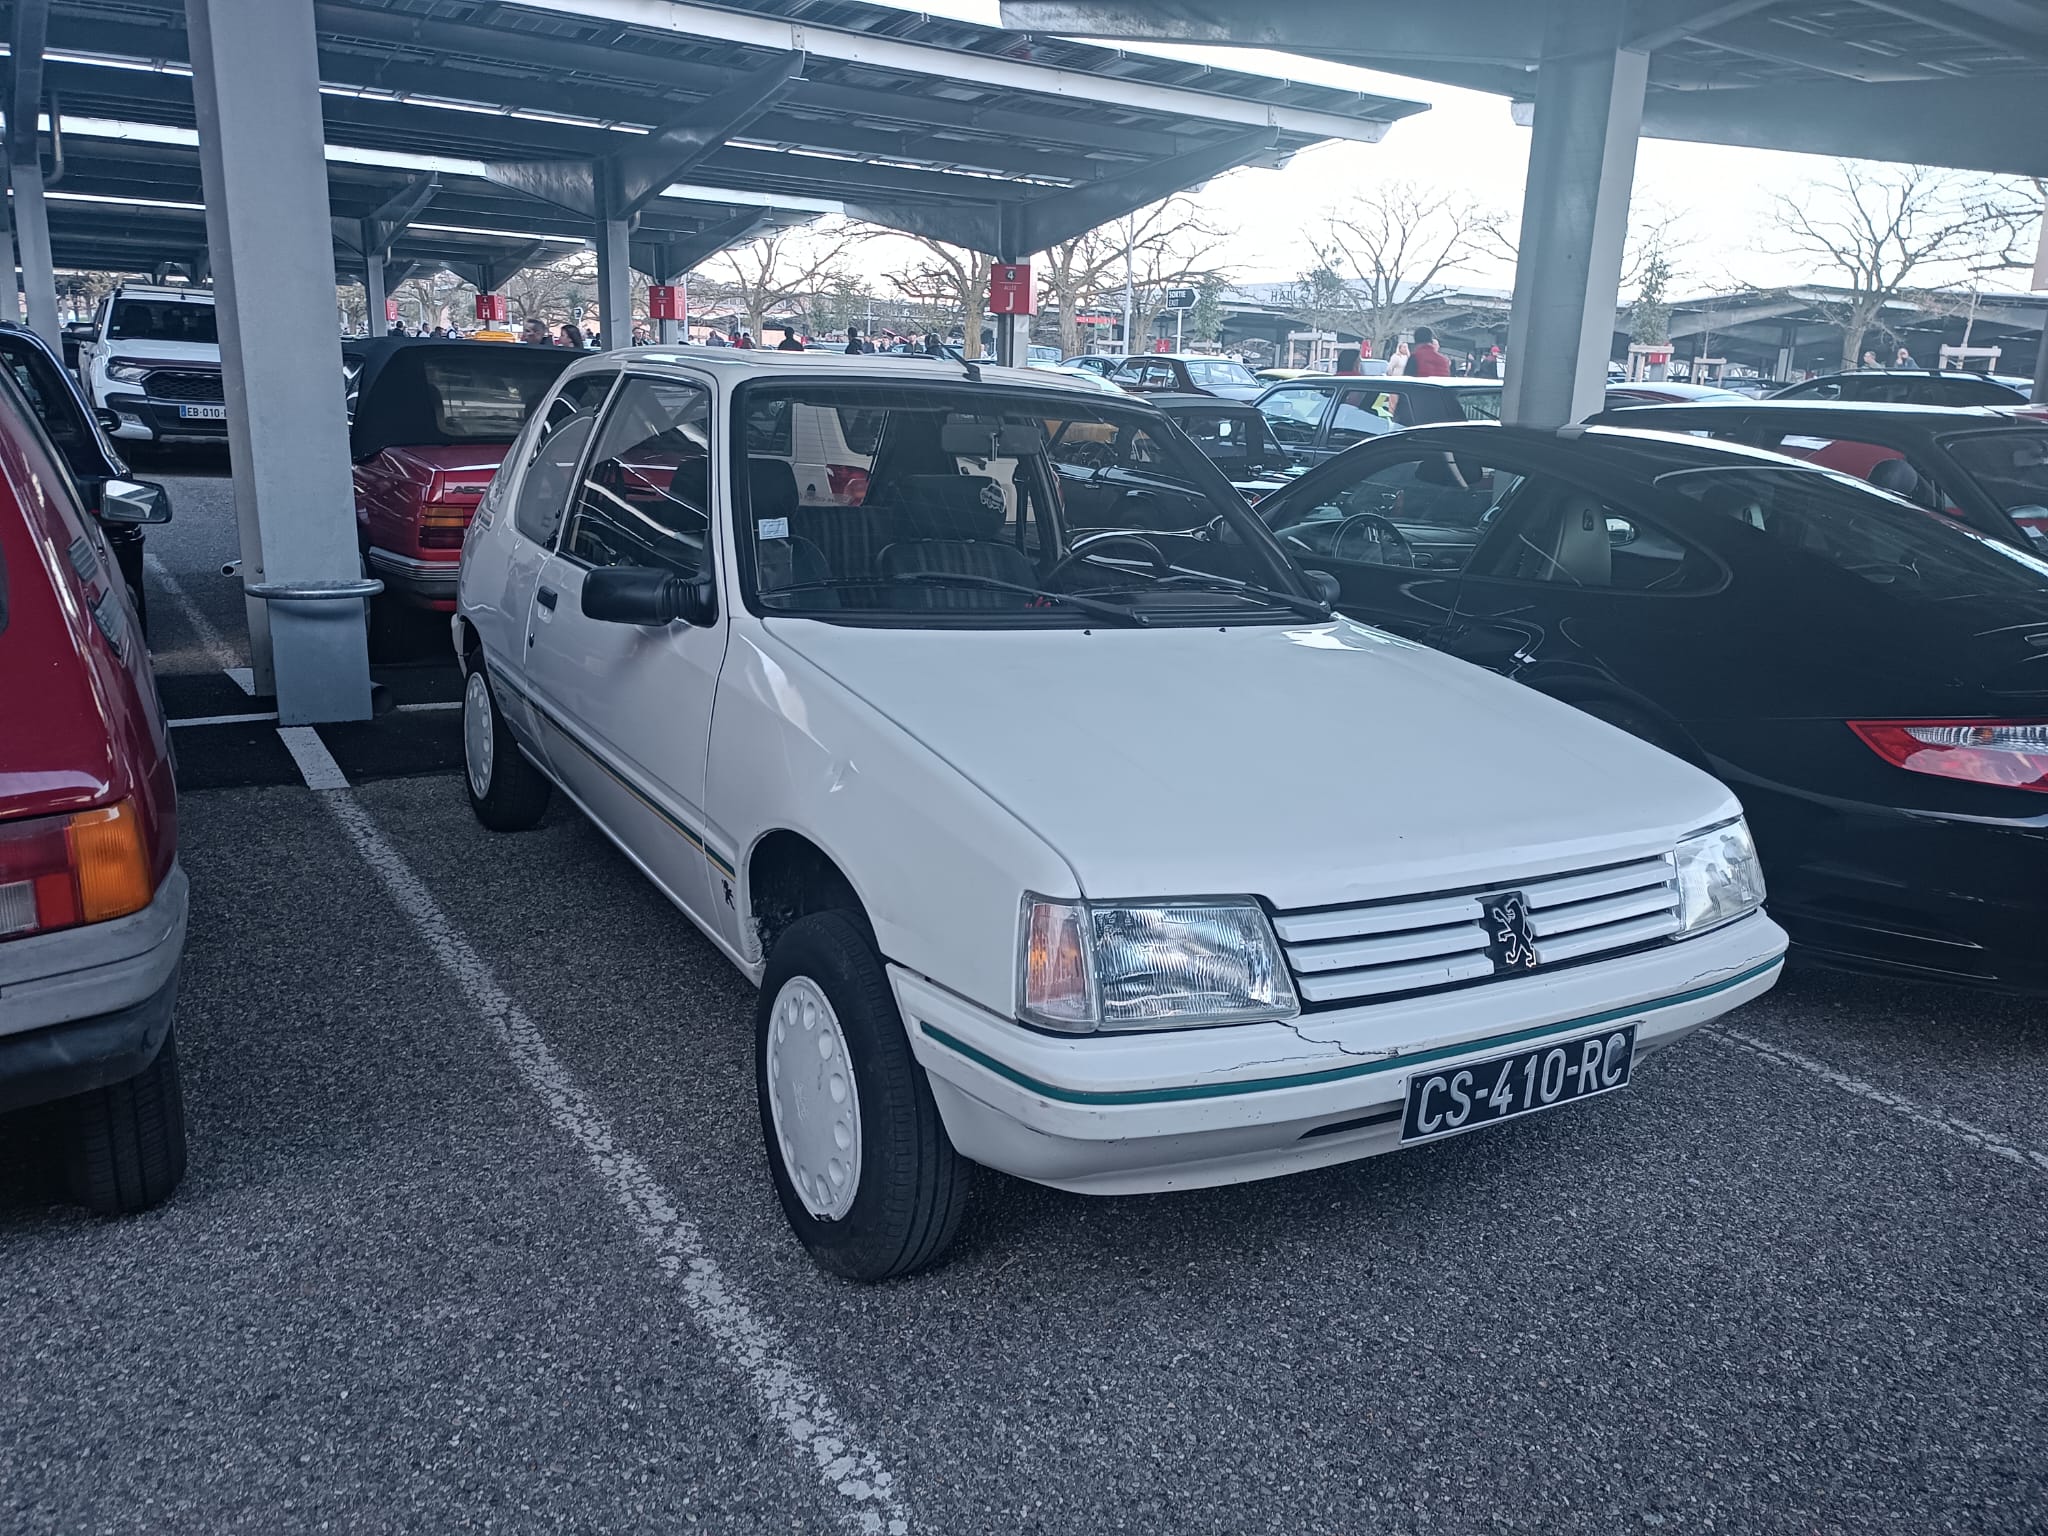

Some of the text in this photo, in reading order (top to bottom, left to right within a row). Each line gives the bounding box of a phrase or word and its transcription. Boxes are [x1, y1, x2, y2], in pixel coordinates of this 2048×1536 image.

[1005, 292, 1014, 311] J
[1168, 299, 1179, 307] EXIT
[482, 308, 490, 318] H
[497, 309, 504, 320] H
[187, 407, 227, 418] EB-010-
[1417, 1033, 1627, 1134] CS-410-RC
